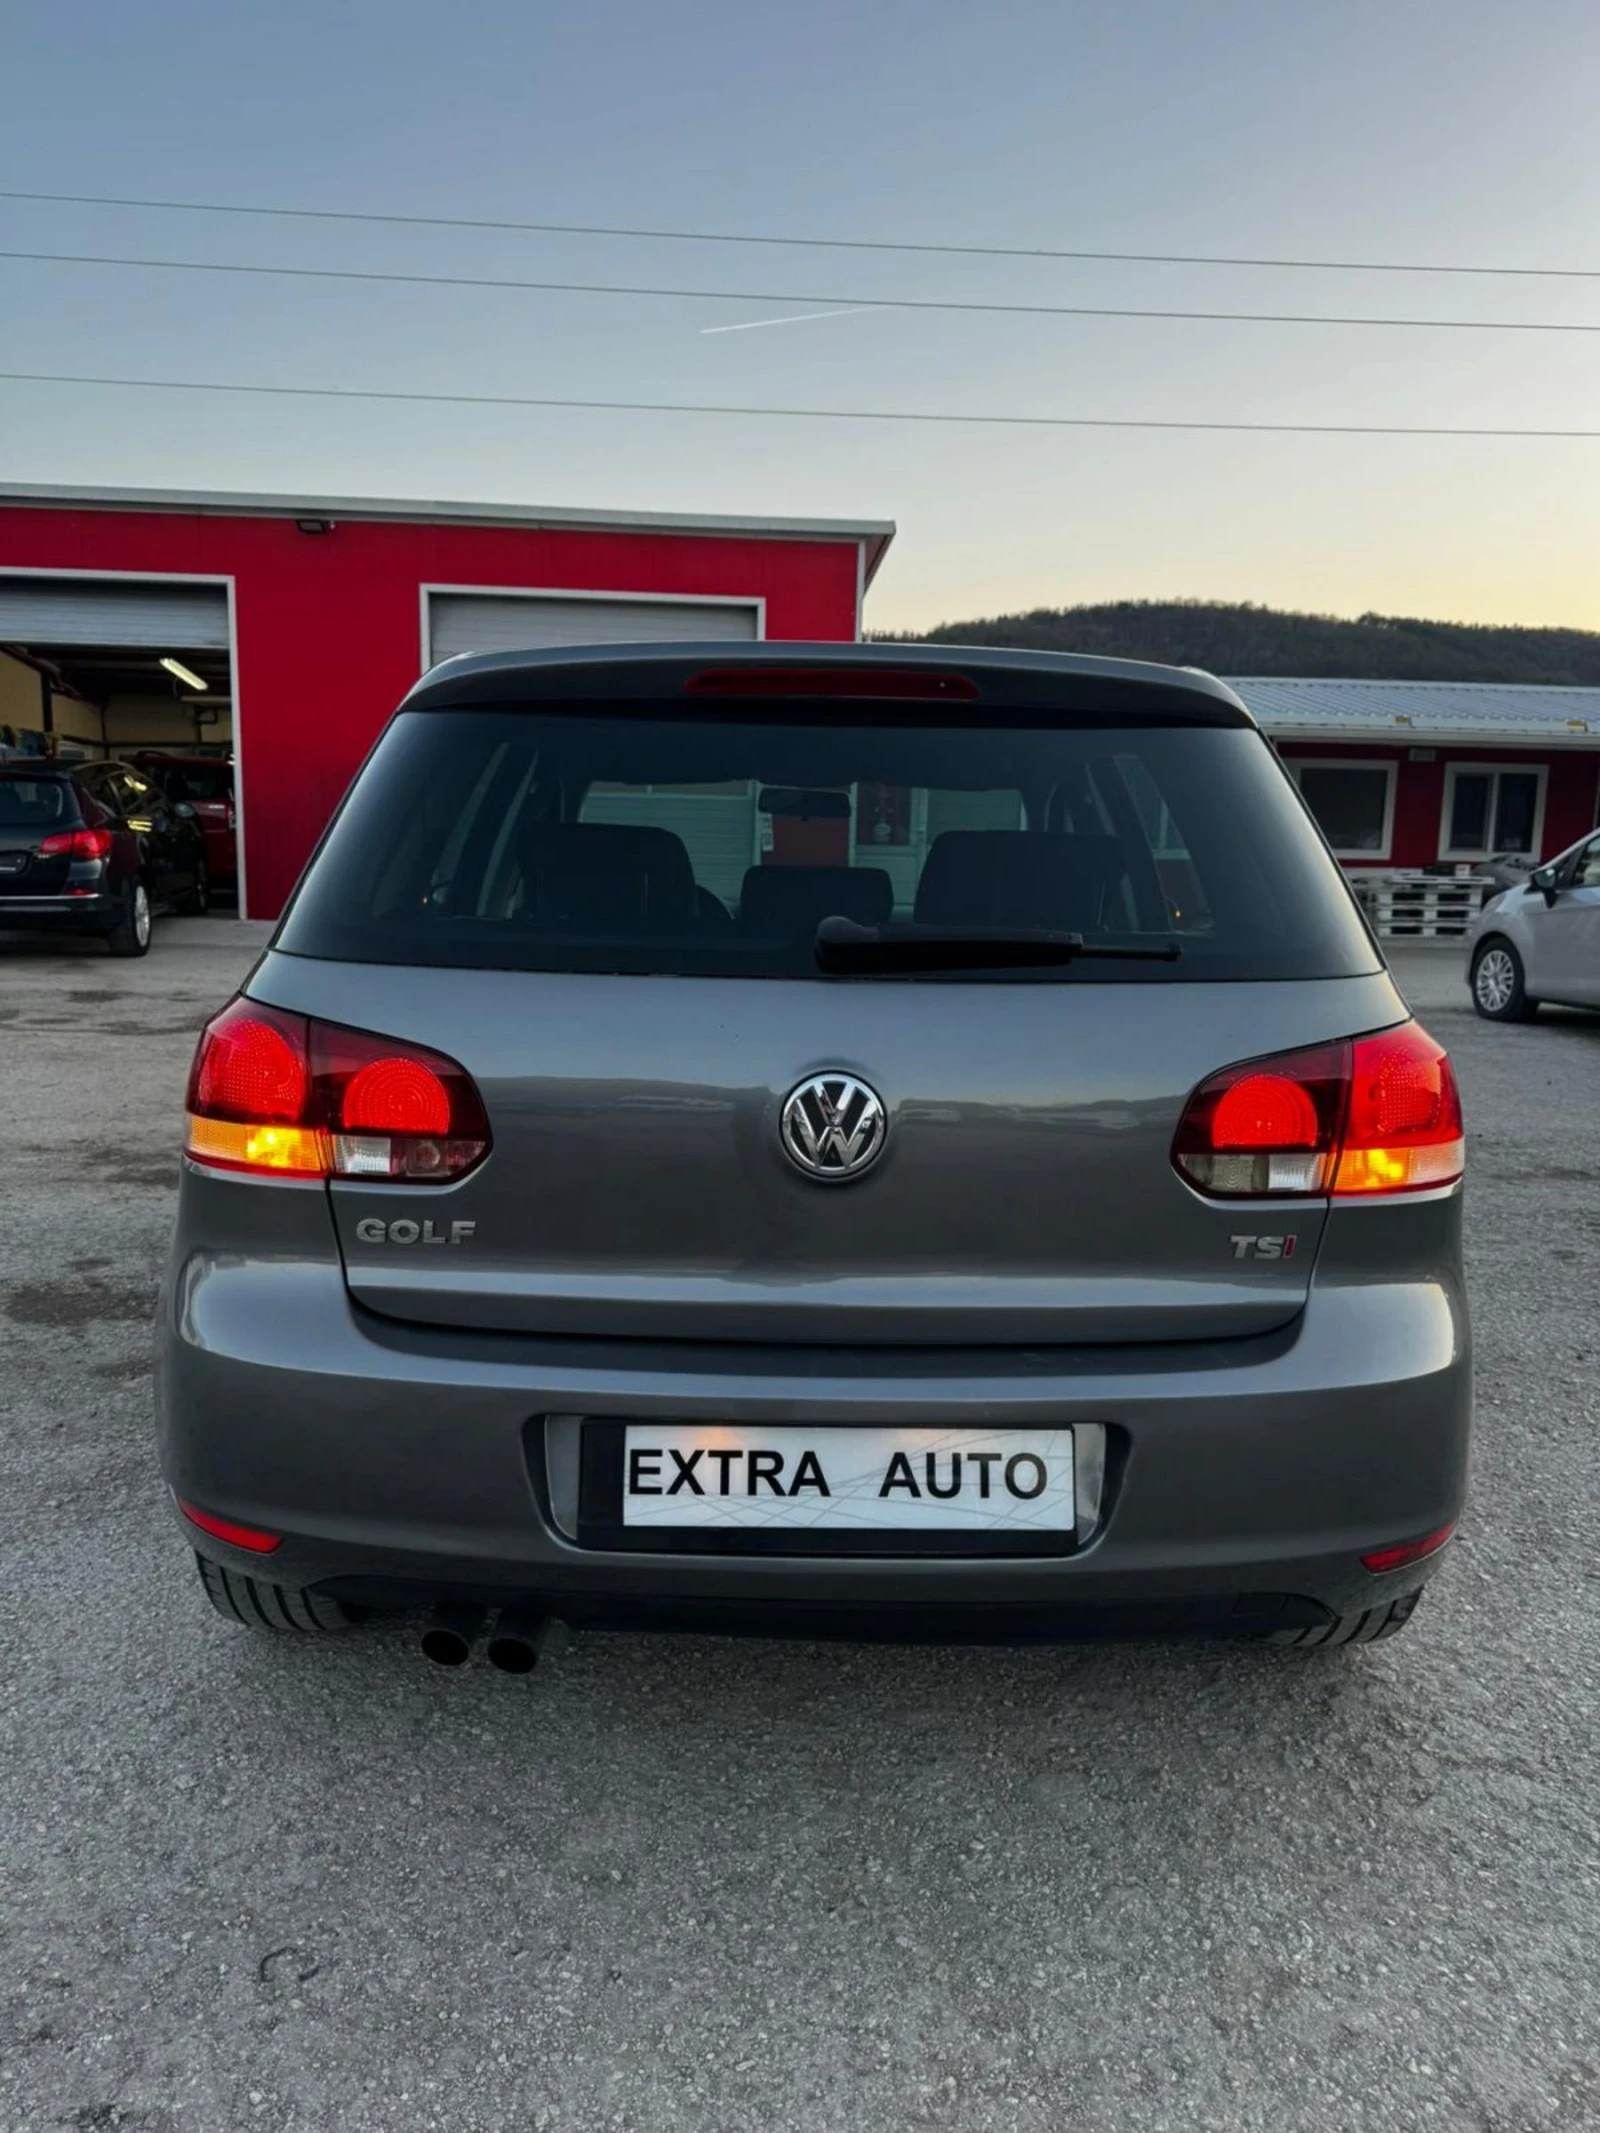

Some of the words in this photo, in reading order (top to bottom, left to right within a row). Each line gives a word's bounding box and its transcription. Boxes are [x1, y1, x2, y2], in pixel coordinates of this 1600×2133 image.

[356, 1218, 477, 1245] GOLF
[1229, 1234, 1298, 1260] TSI
[628, 1449, 832, 1497] EXTRA
[878, 1451, 1049, 1500] AUTO
